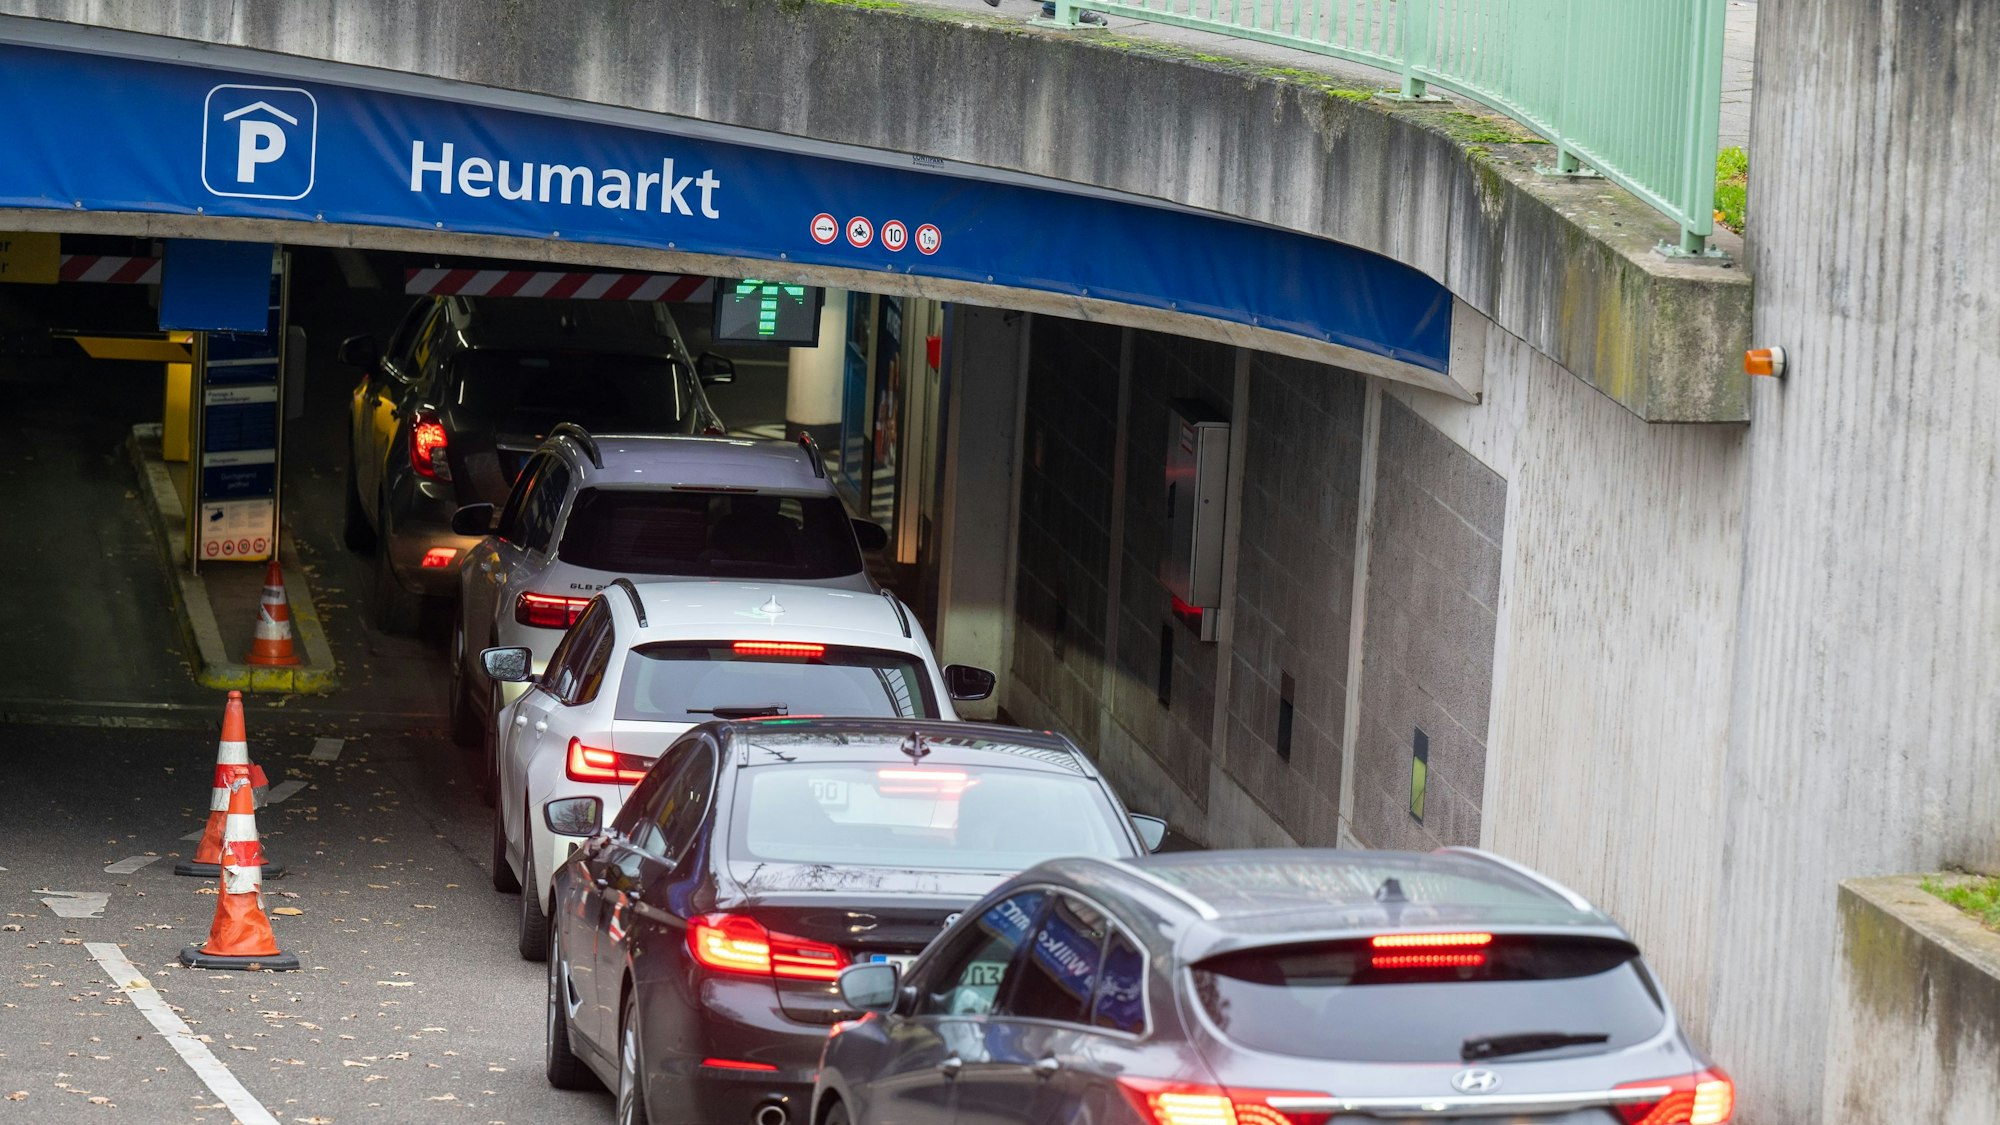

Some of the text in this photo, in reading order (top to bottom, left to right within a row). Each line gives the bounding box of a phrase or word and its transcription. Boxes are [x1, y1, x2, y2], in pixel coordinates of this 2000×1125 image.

[236, 120, 287, 183] P
[410, 140, 721, 219] Heumarkt
[888, 228, 902, 243] 10
[570, 583, 593, 591] GLB
